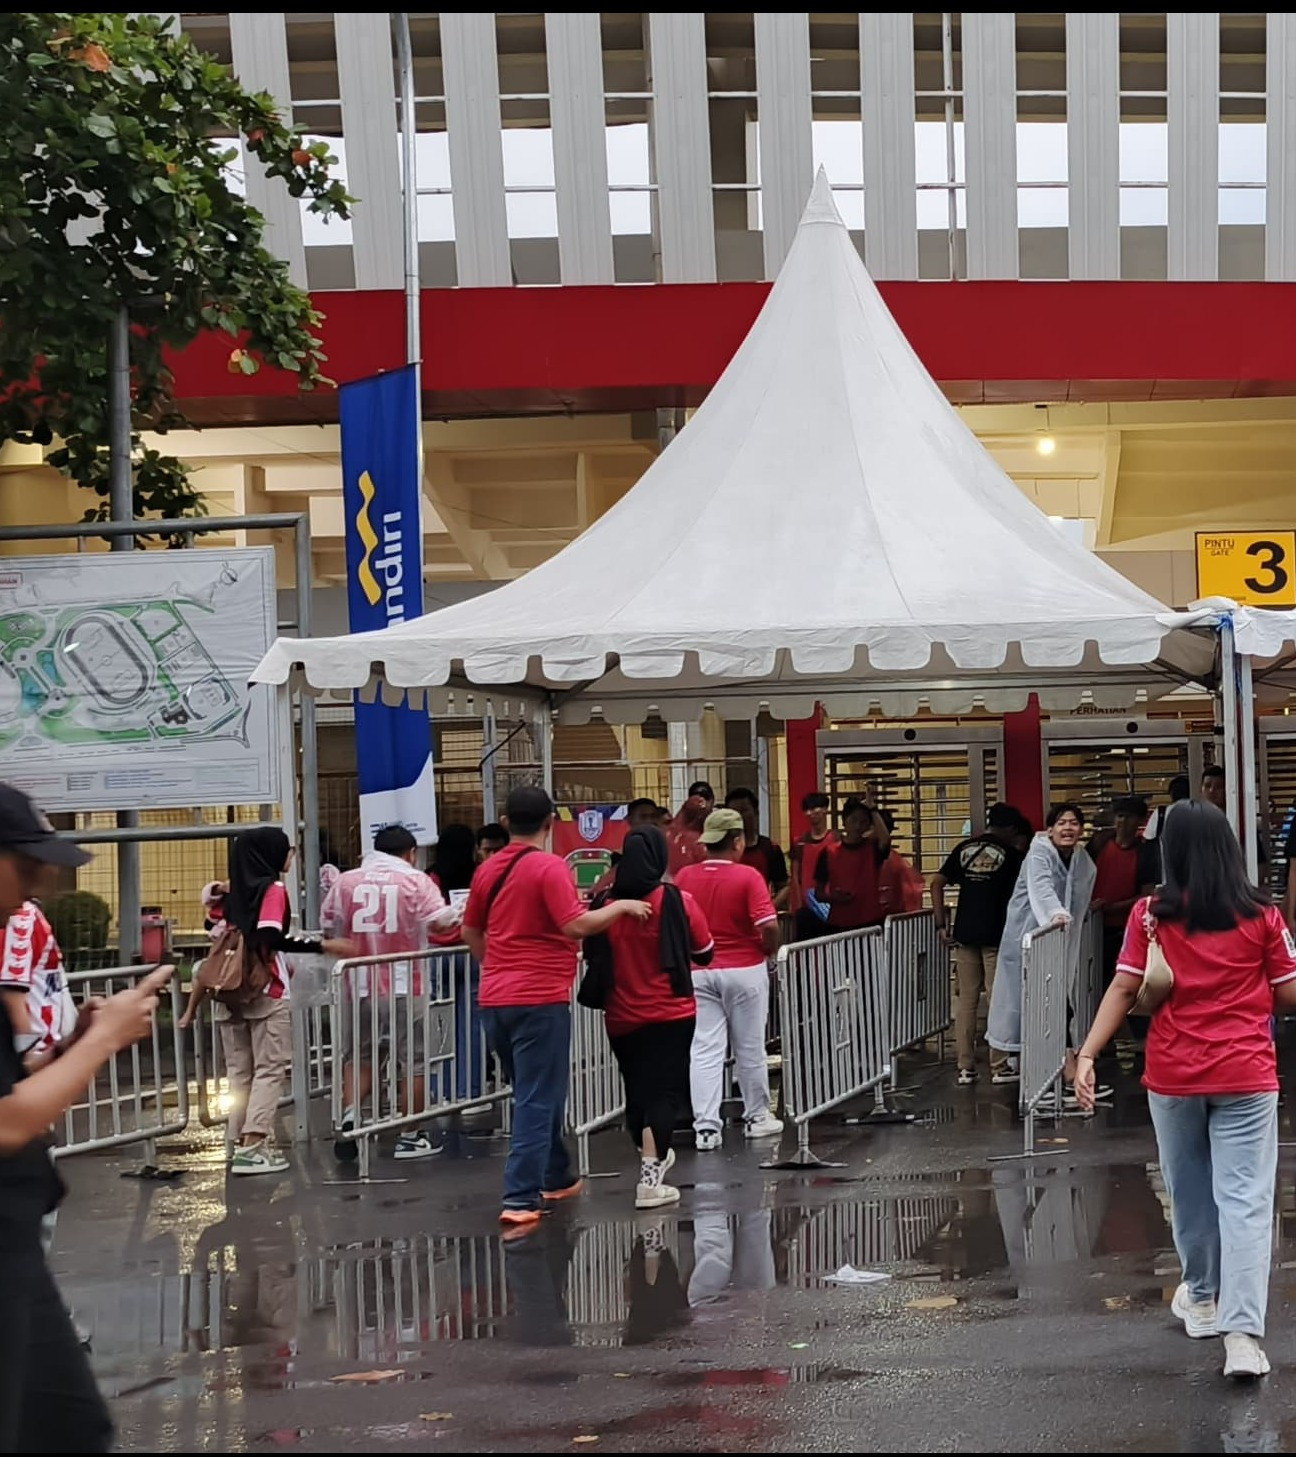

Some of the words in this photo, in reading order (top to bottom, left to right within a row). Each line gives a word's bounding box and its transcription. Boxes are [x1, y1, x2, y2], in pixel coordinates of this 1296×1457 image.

[1204, 539, 1235, 549] PINTU
[1244, 541, 1288, 593] 3
[375, 511, 405, 628] ndiri
[352, 884, 399, 933] 21
